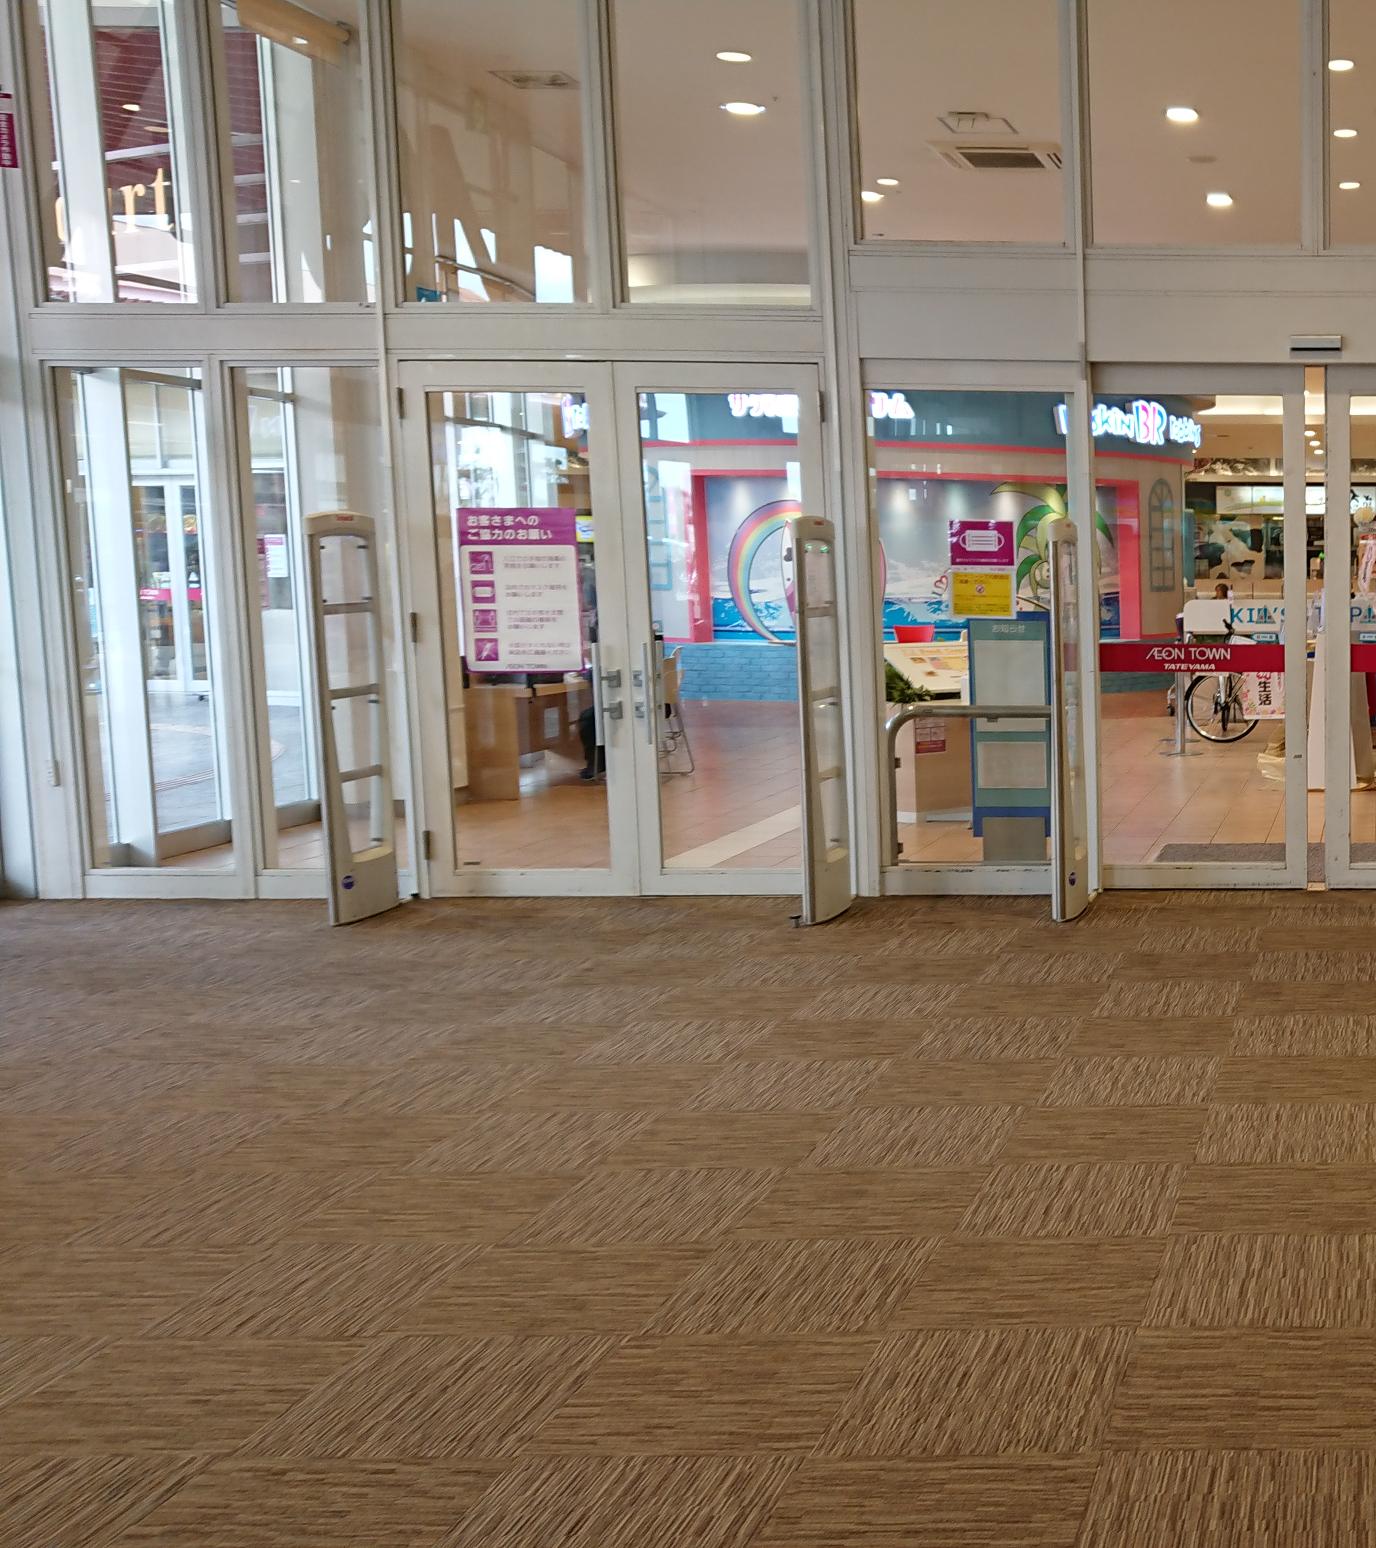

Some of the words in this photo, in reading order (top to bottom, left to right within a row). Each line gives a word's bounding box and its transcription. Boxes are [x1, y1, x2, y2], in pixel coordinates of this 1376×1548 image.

[466, 515, 540, 527] お客さまへの
[466, 528, 553, 541] ご協力のお願い
[1189, 647, 1231, 661] TOWN
[1163, 663, 1216, 671] TATEYAMA
